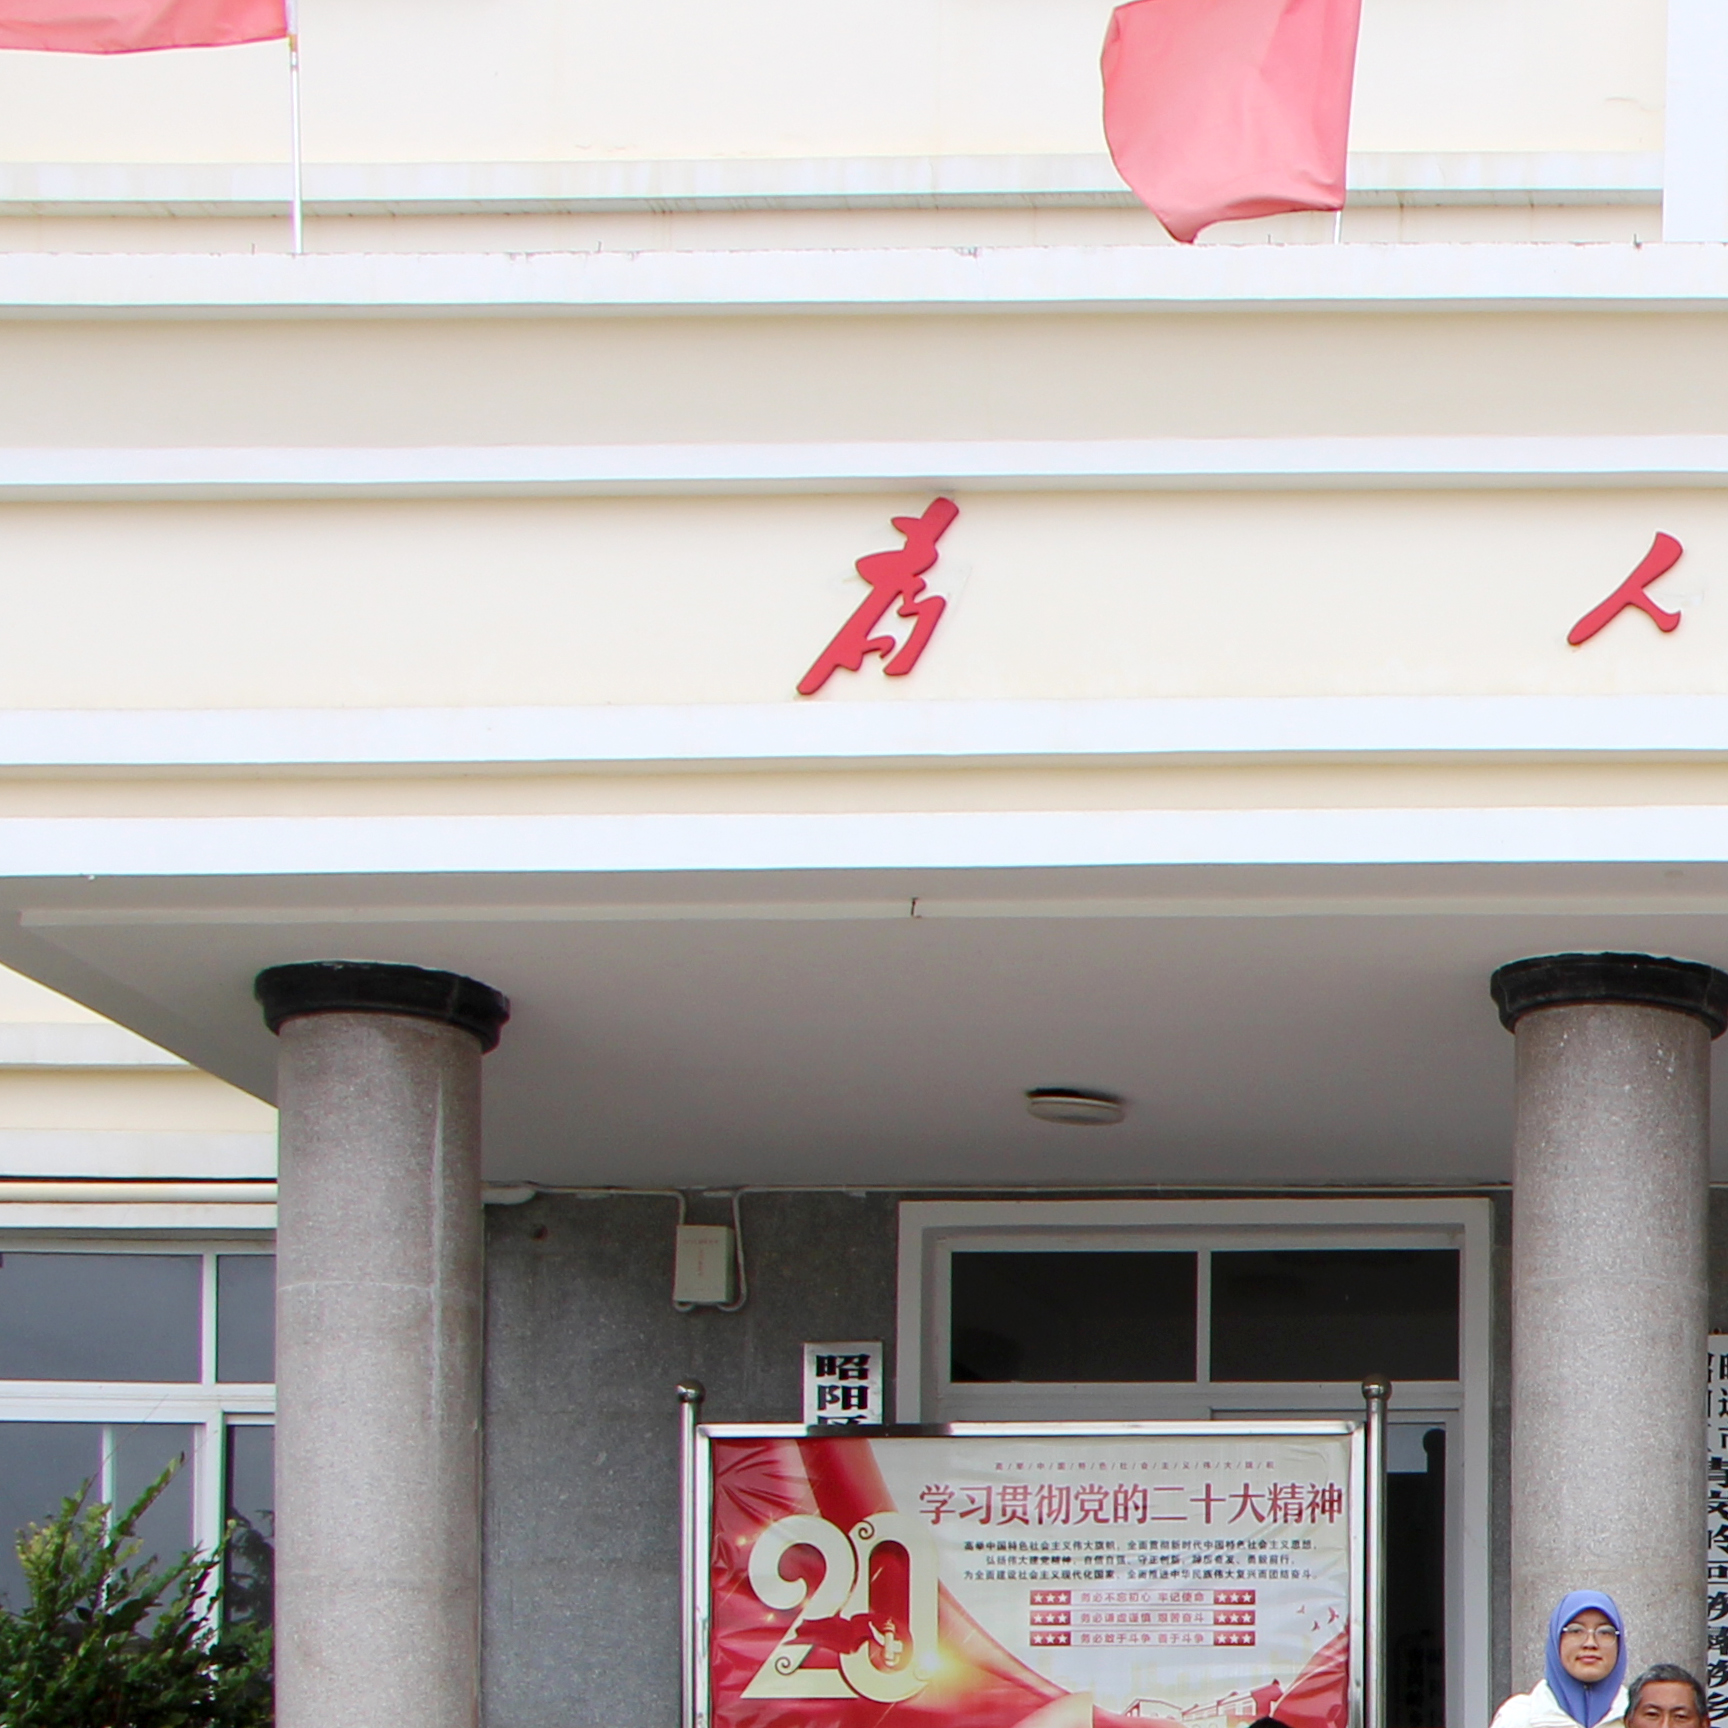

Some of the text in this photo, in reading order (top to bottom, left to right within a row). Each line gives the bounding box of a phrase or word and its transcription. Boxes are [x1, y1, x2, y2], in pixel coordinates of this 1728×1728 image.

[919, 1483, 1343, 1527] 学习贯彻党的二十大精神
